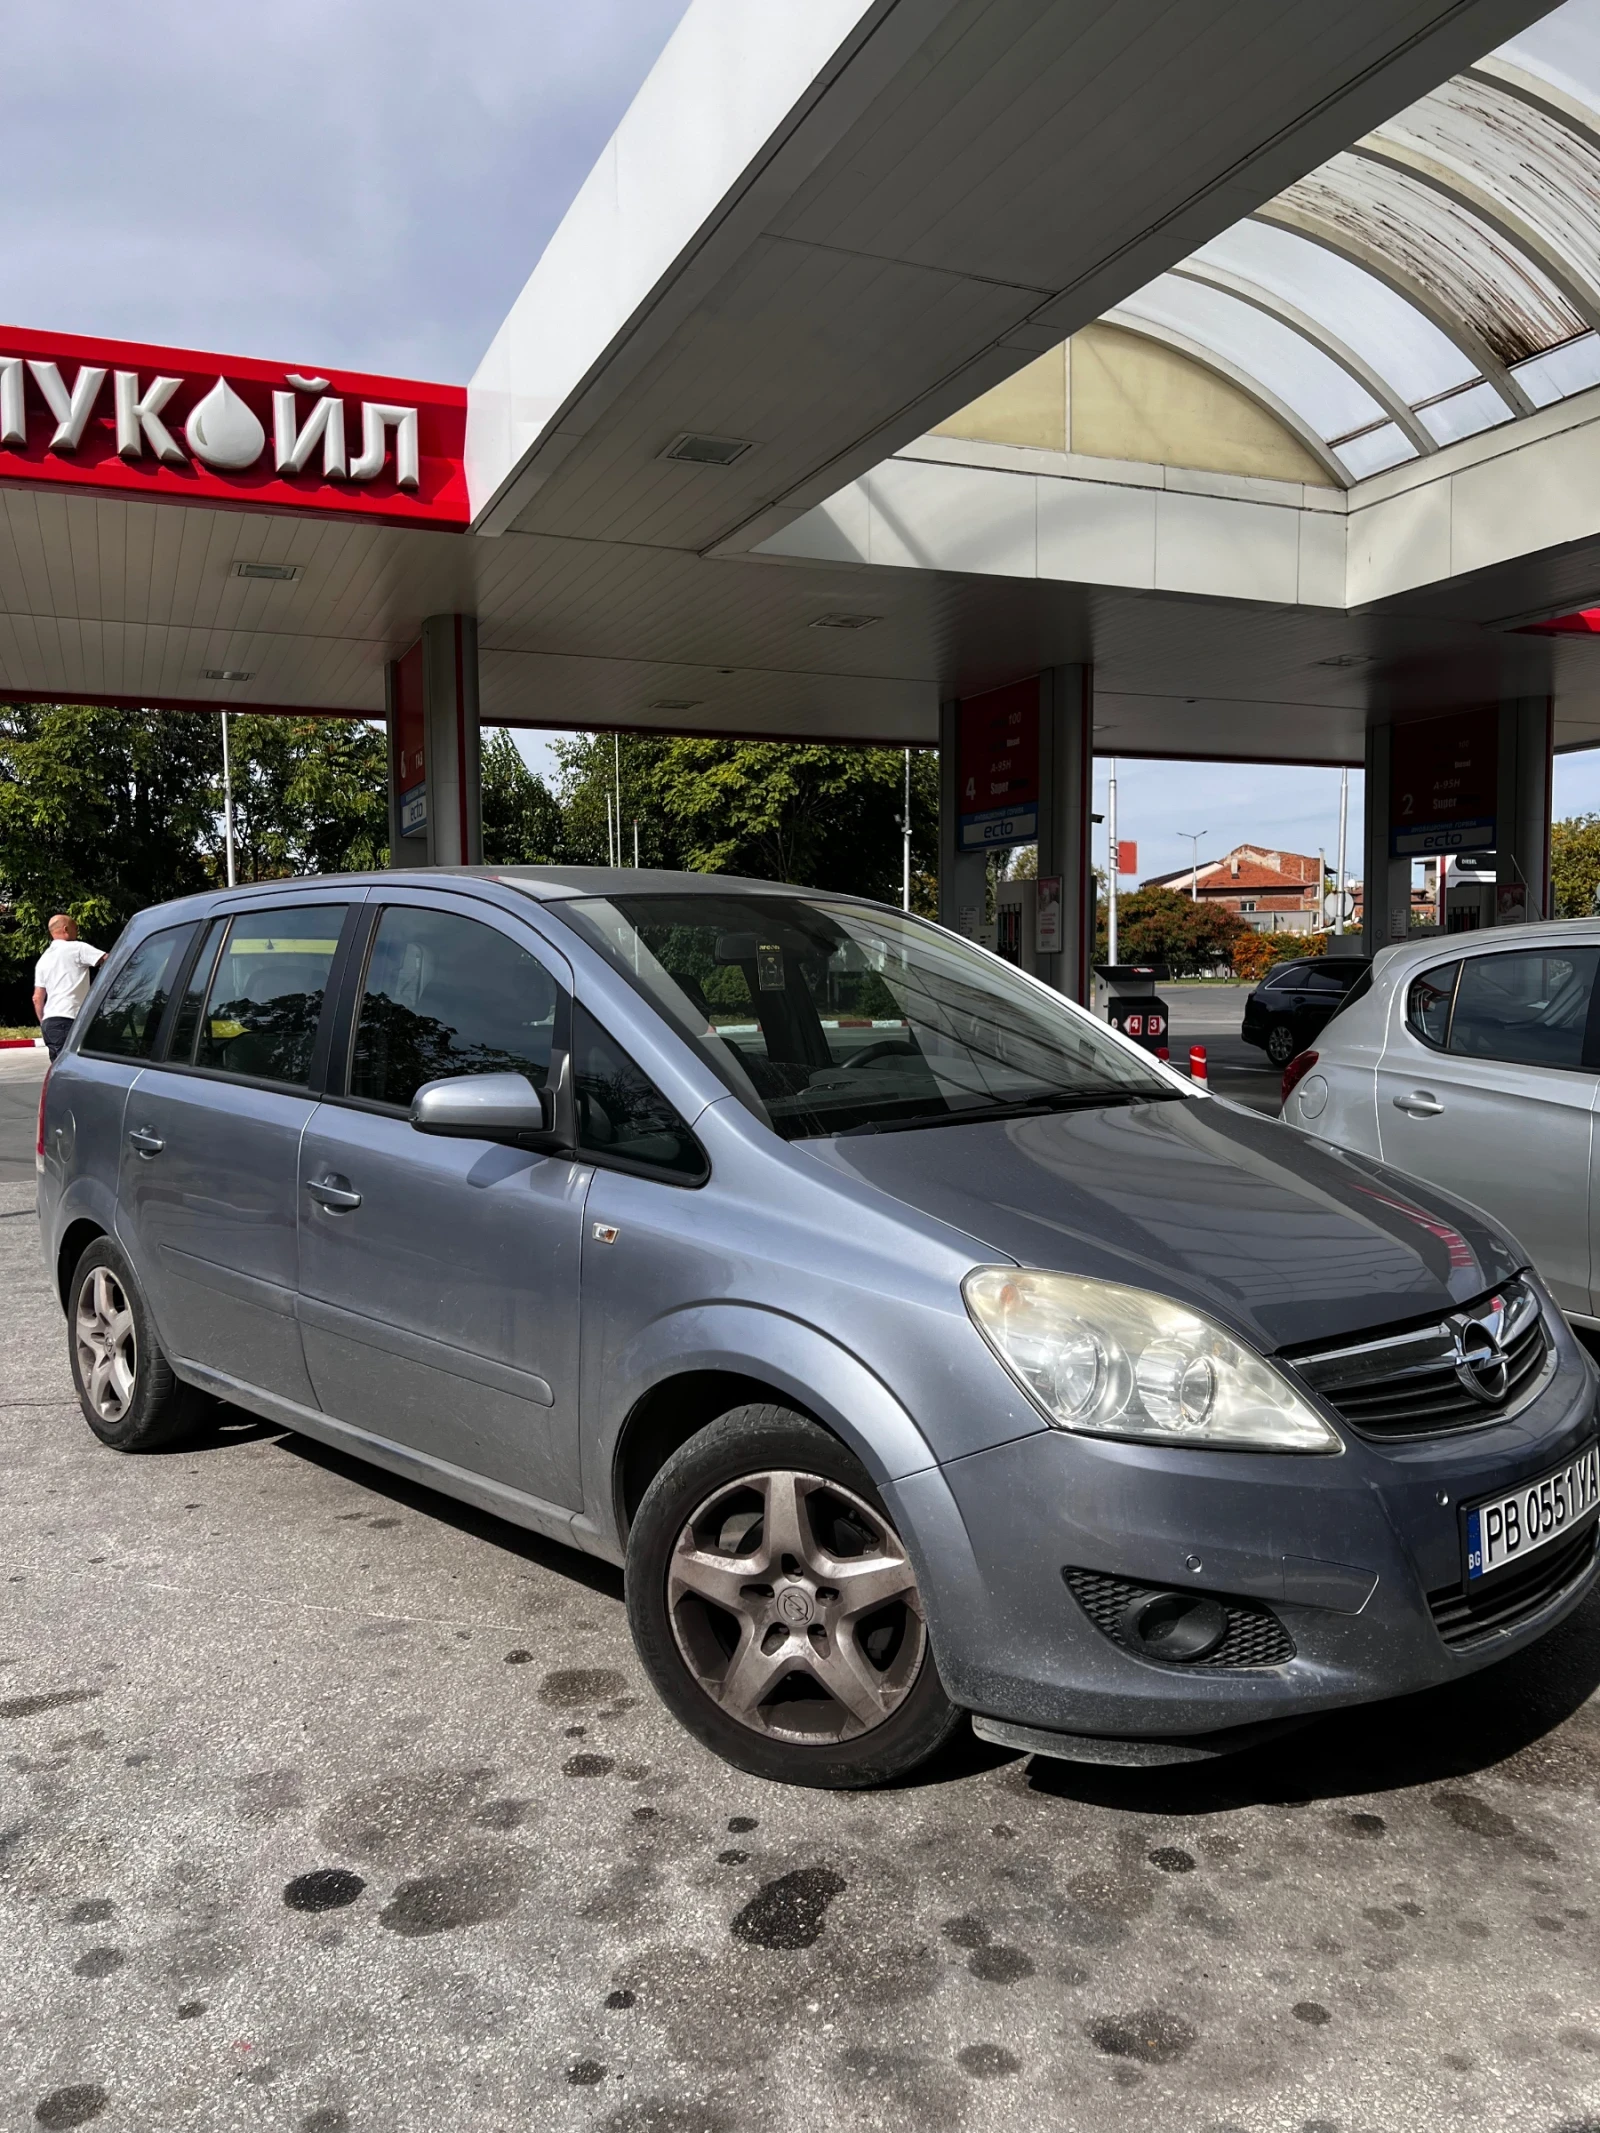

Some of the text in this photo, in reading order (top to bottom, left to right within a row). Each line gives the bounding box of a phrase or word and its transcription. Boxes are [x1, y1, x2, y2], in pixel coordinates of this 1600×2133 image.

[1008, 712, 1022, 726] 100
[400, 750, 406, 779] 6
[965, 776, 976, 801] 4
[990, 780, 1010, 796] Super
[411, 801, 423, 822] ecto
[1401, 792, 1415, 816] 2
[1432, 797, 1458, 811] Super
[983, 820, 1014, 839] ecto
[1423, 831, 1463, 849] ecto
[1131, 1018, 1158, 1030] 4 3
[1485, 1499, 1522, 1563] PB
[1526, 1467, 1574, 1542] 0551
[1468, 1550, 1481, 1570] BG
